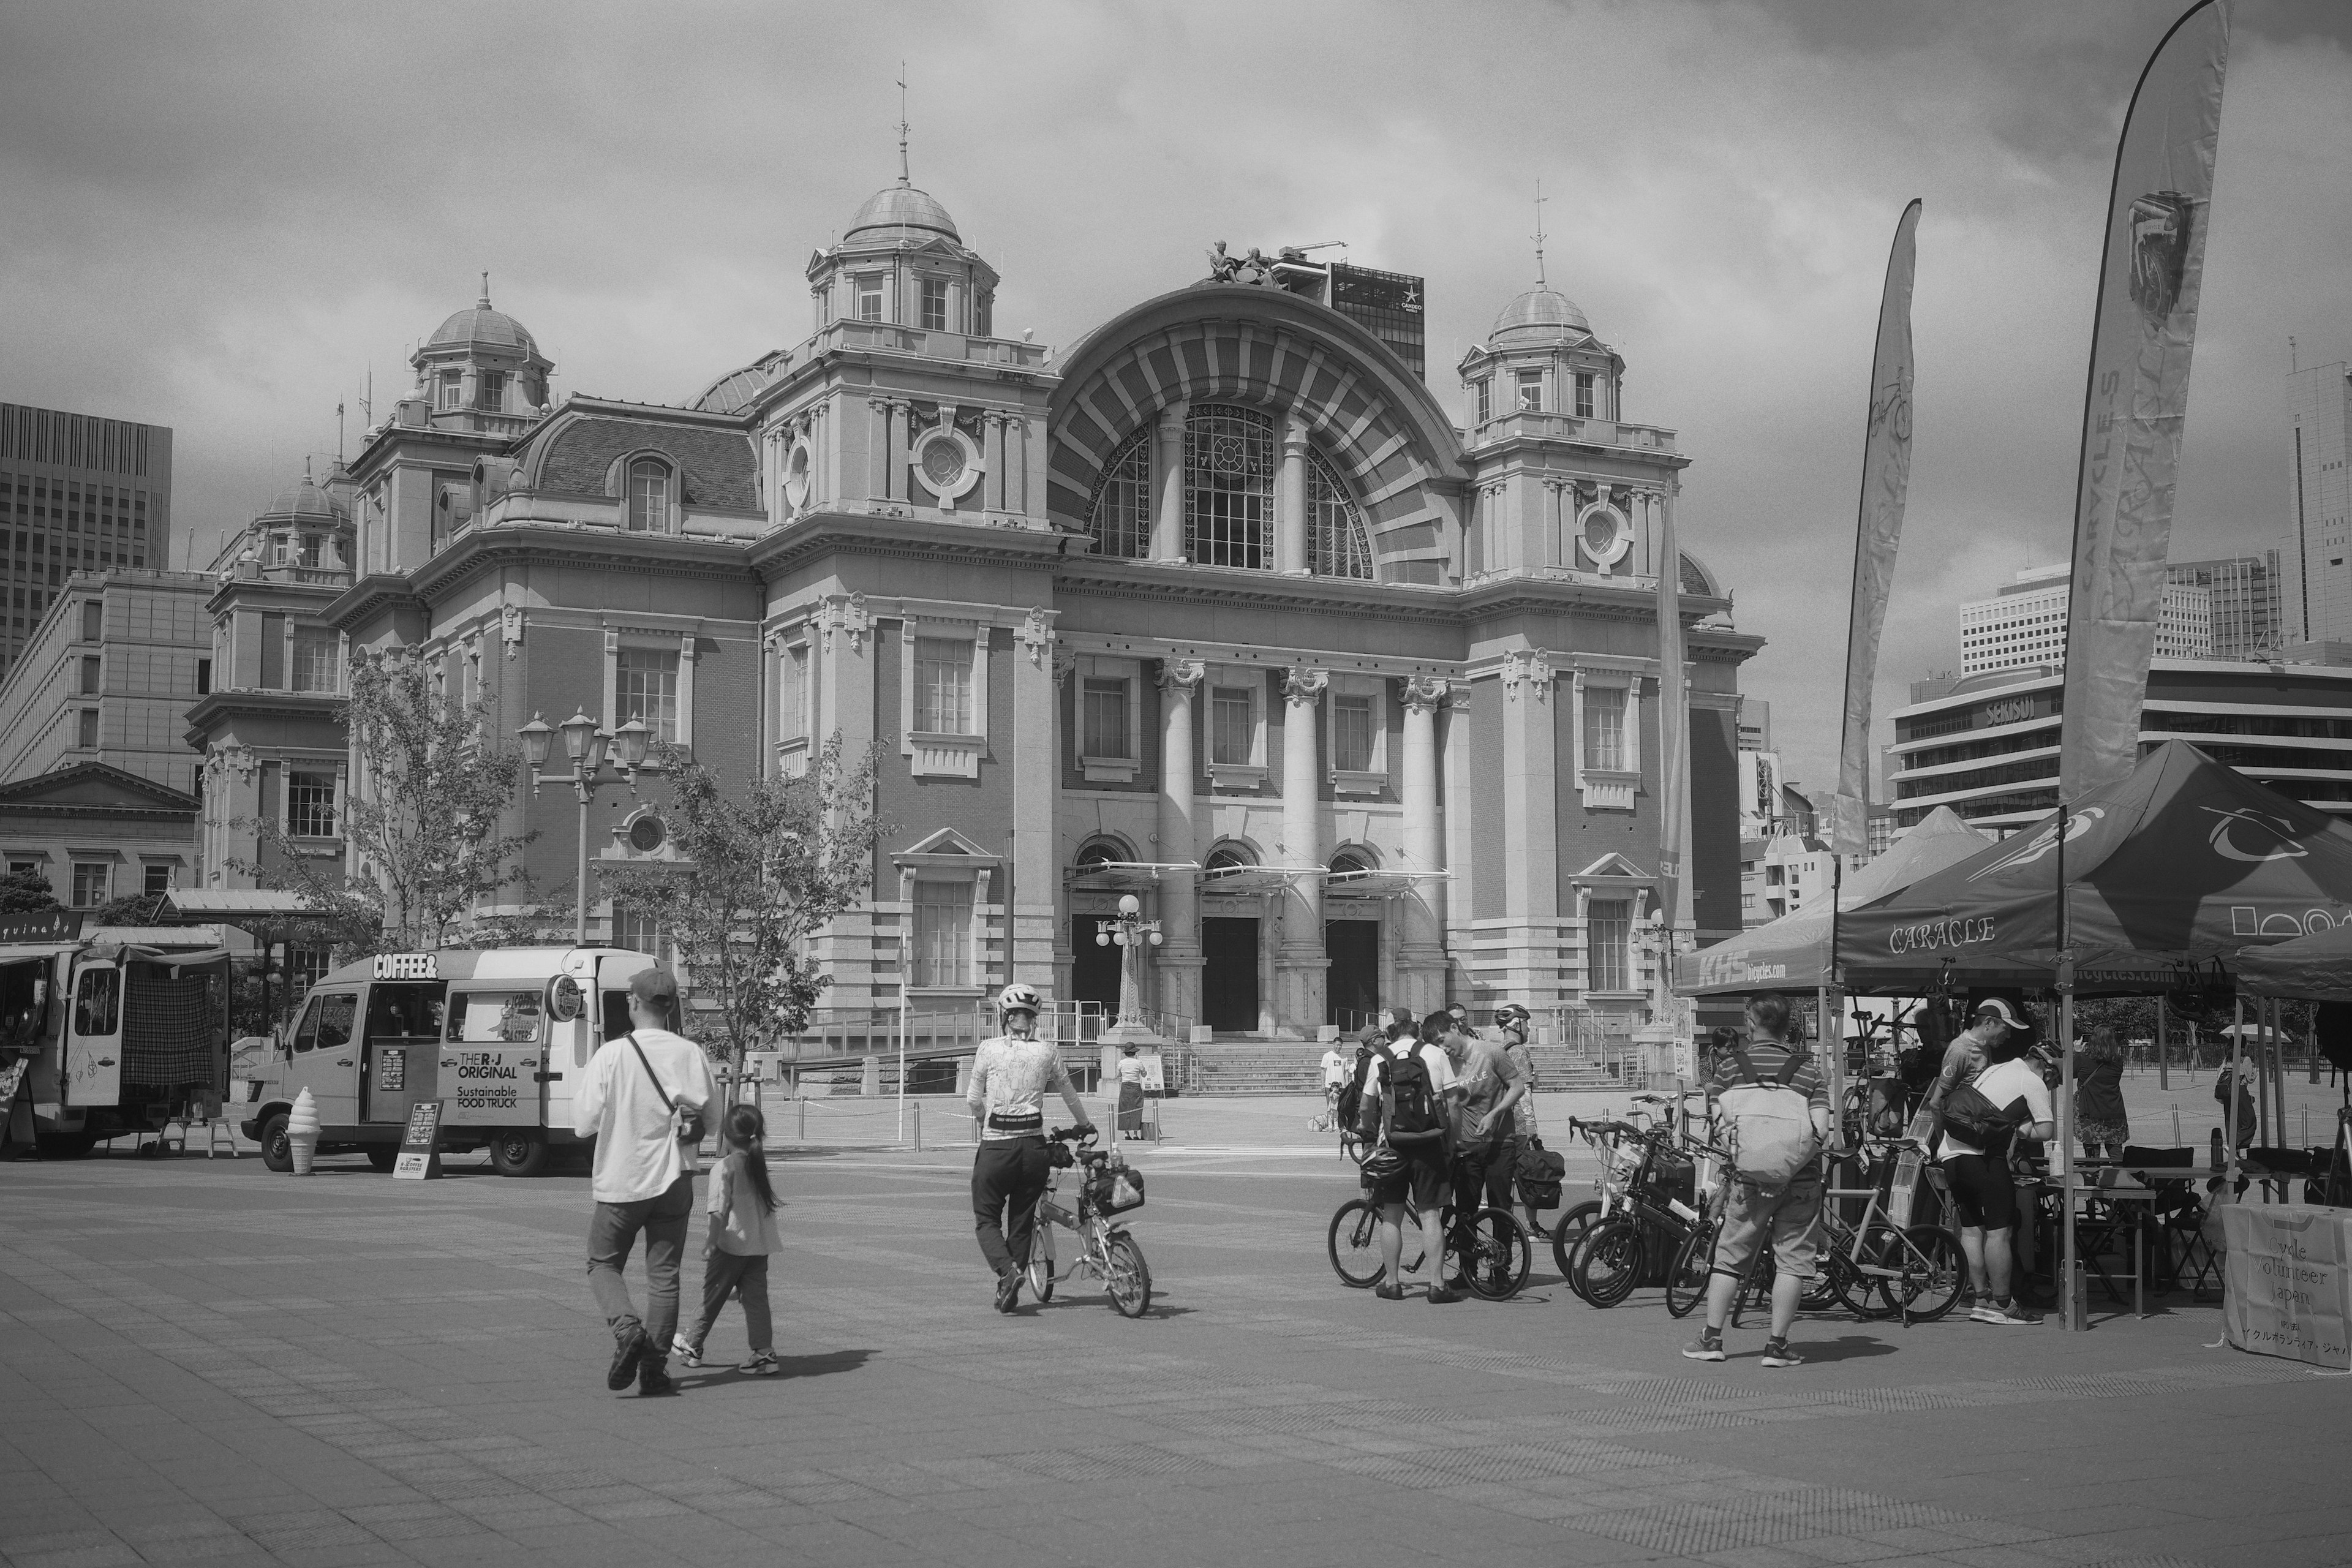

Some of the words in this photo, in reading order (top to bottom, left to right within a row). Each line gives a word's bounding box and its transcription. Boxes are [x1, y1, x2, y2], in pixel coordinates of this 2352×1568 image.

[1986, 696, 2035, 726] SEKISUI
[1890, 917, 1996, 954] CARACLE
[1698, 949, 1749, 987] KHS
[1747, 962, 1785, 982] bicycles.com
[460, 1053, 481, 1065] THE
[458, 1066, 517, 1079] ORIGINAL
[457, 1085, 517, 1097] Sustainable
[458, 1098, 485, 1108] FOOD
[486, 1098, 517, 1108] TRUCK
[2268, 1237, 2307, 1260] Cycle
[2252, 1254, 2329, 1286] Volunteer
[2270, 1281, 2310, 1311] Japan
